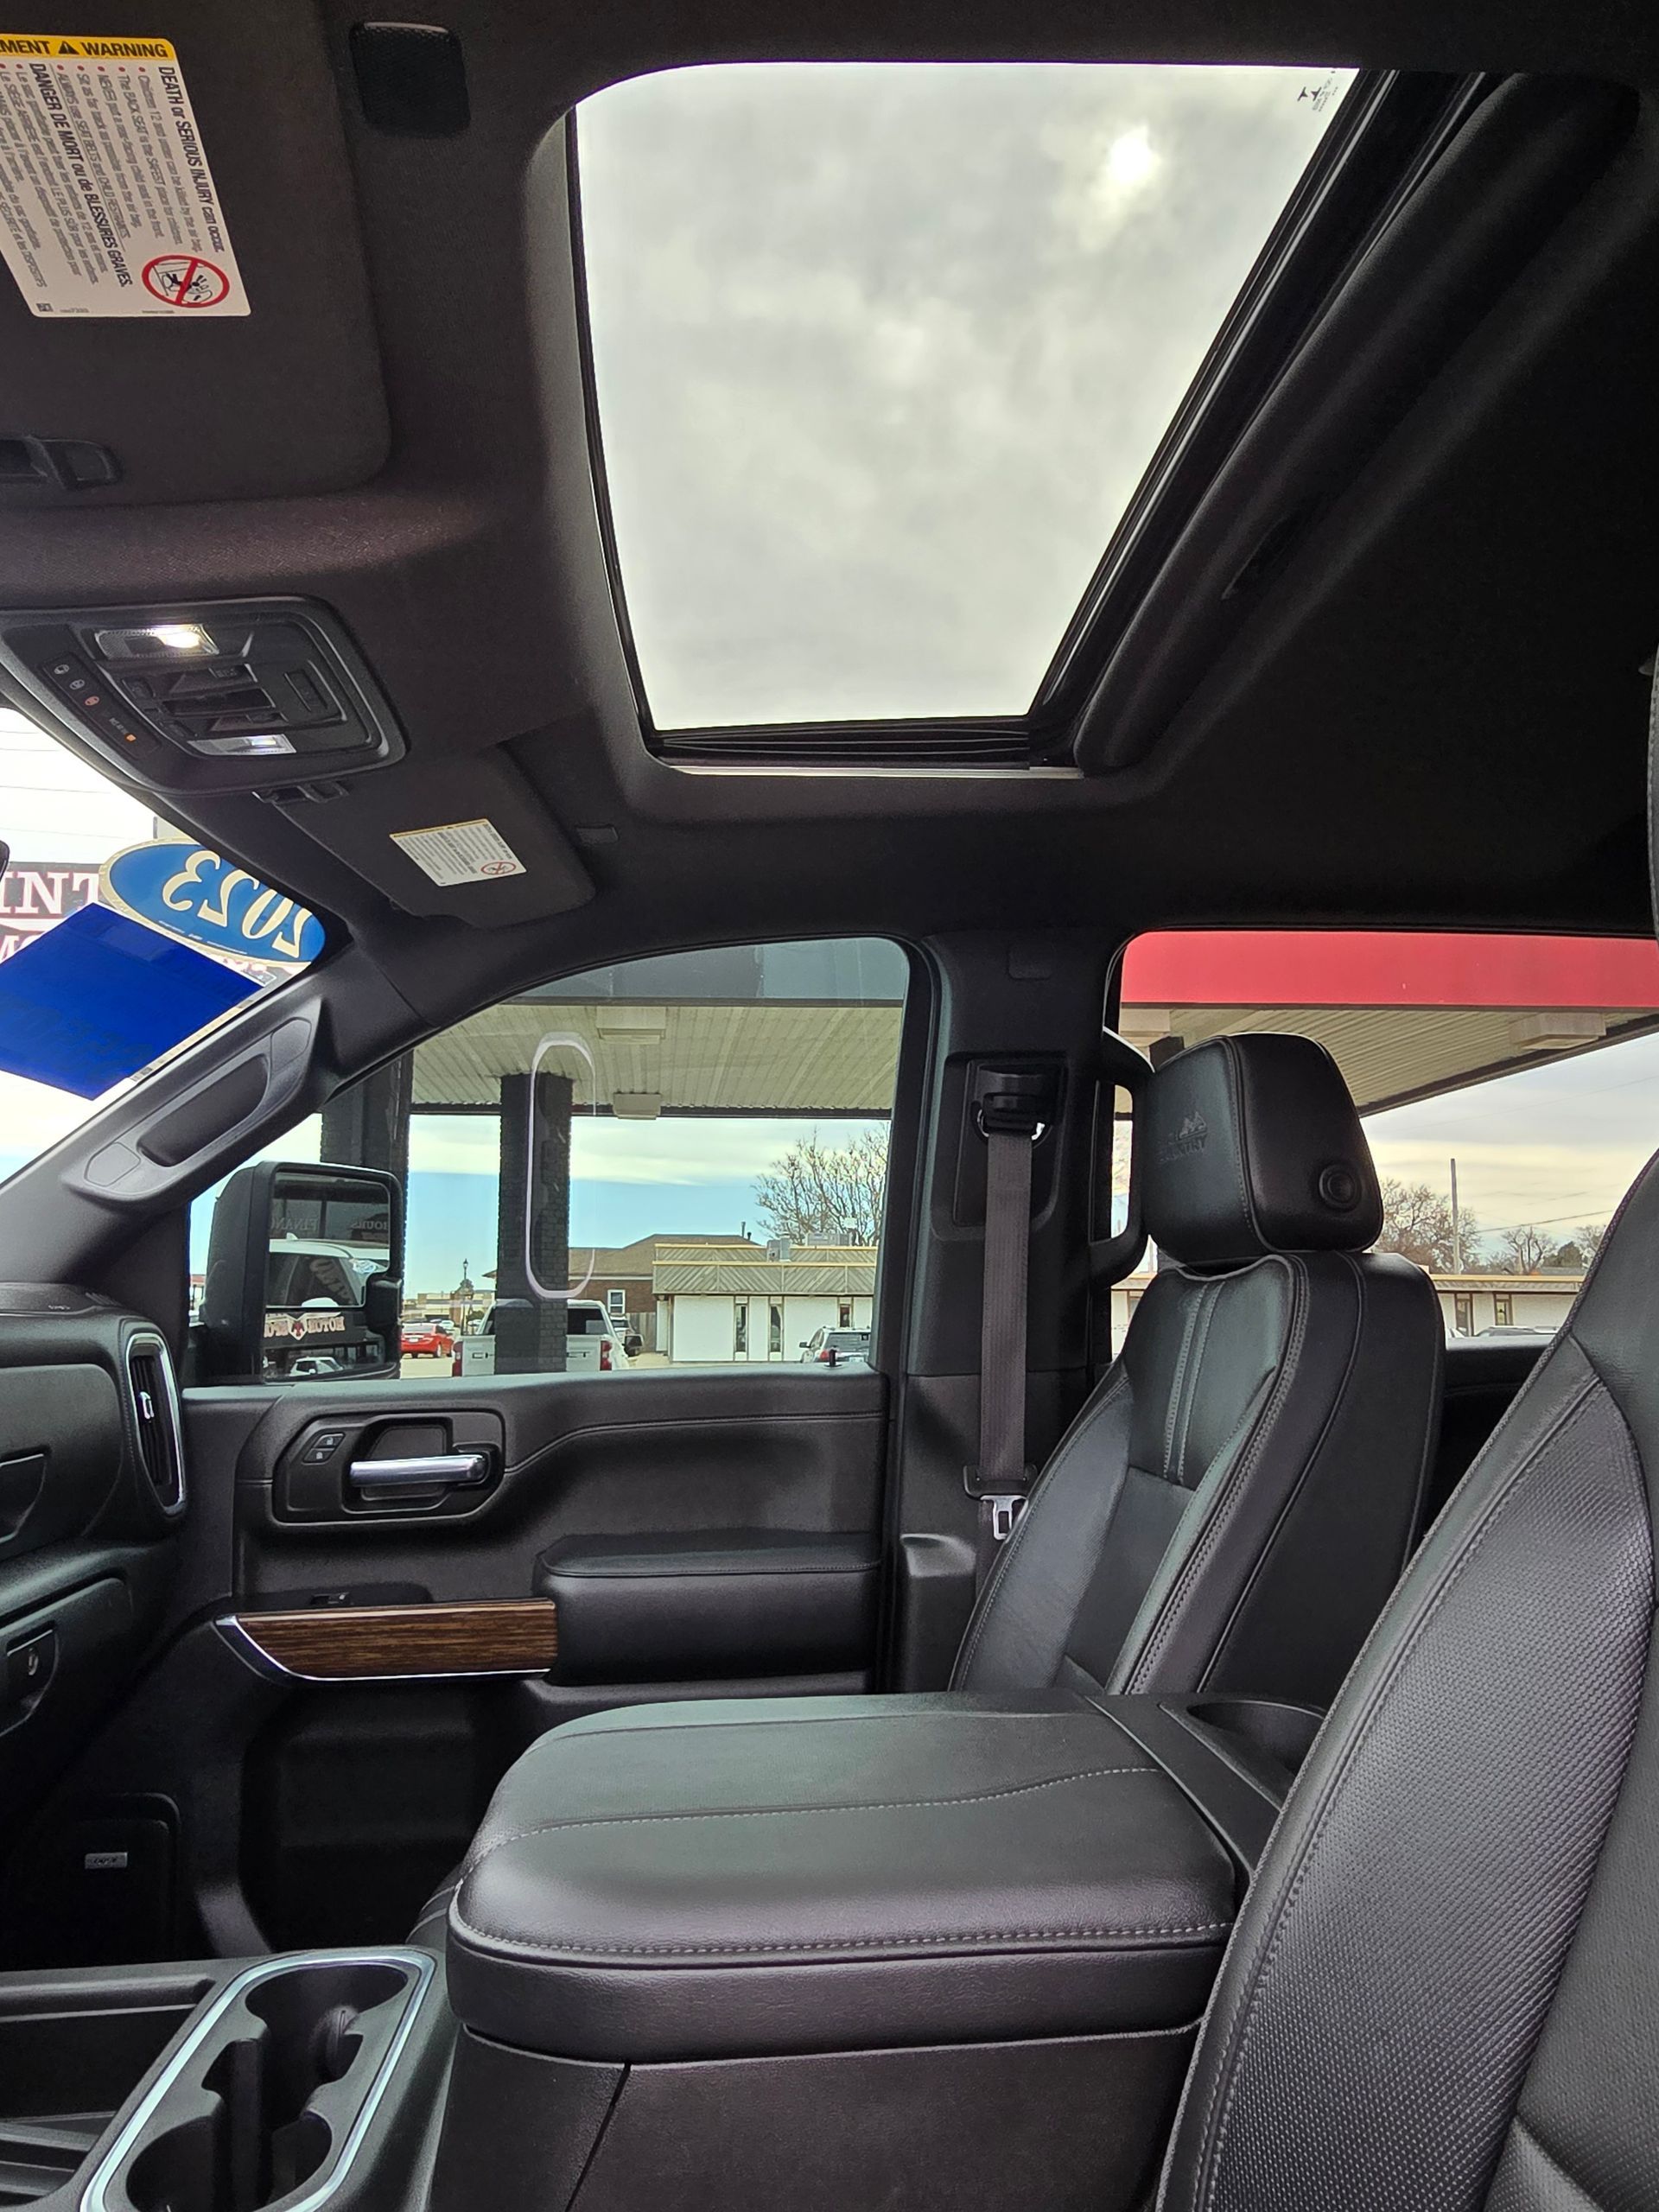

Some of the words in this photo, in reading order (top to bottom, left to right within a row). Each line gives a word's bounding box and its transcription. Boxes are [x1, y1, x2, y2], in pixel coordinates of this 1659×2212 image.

[0, 40, 50, 54] MENT
[81, 42, 168, 58] WARNING
[28, 62, 64, 111] DANGER
[117, 74, 134, 90] The
[157, 66, 184, 104] DEATH
[122, 91, 142, 113] BACK
[169, 106, 186, 118] or
[48, 112, 71, 128] DE
[130, 114, 149, 134] SEAT
[55, 130, 84, 162] MORT
[174, 120, 203, 166] SERIOUS
[69, 162, 87, 176] ou
[75, 178, 96, 191] de
[188, 168, 214, 205] INJURY
[81, 194, 118, 248] BLESSURES
[200, 207, 216, 224] can
